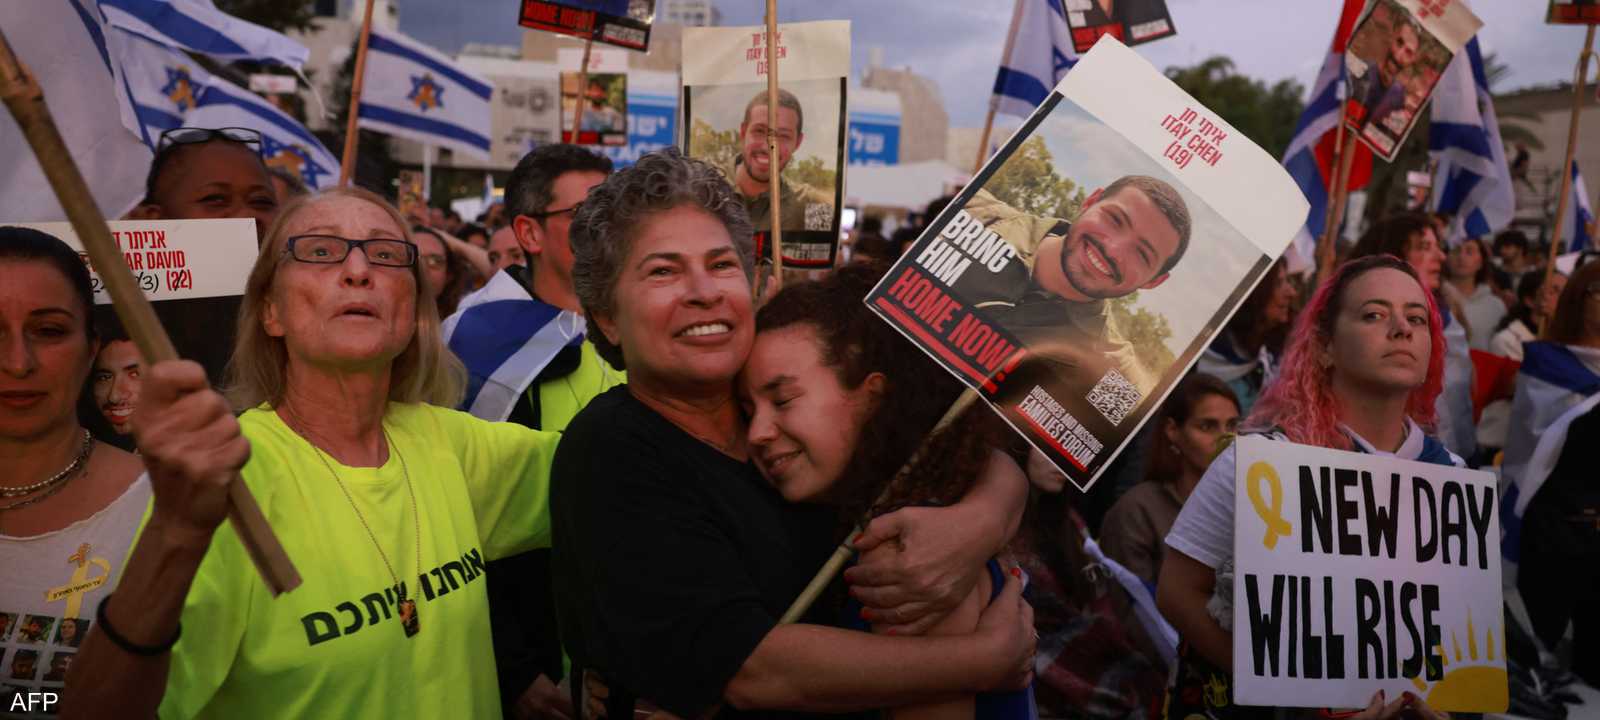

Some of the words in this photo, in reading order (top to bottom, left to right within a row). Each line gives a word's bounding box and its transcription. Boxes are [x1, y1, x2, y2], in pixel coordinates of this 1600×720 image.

[1161, 114, 1192, 140] ITAY
[1187, 134, 1223, 167] CHEN
[1179, 107, 1198, 125] חן
[1199, 117, 1228, 146] איתי
[1163, 140, 1194, 170] (19)
[124, 230, 167, 250] אביתר
[146, 250, 186, 270] DAVID
[915, 236, 973, 288] HIM
[940, 209, 1016, 273] BRING
[887, 266, 963, 334] HOME
[947, 312, 1027, 382] NOW!
[1019, 394, 1065, 439] FAMILIES
[1057, 430, 1097, 468] FORUM
[1030, 384, 1066, 420] HOSTAGES
[1060, 412, 1079, 431] AND
[1071, 423, 1105, 455] MISSING
[1299, 465, 1401, 559] NEW
[1412, 476, 1494, 570] DAY
[419, 547, 486, 602] אנחנו
[1244, 573, 1345, 680] WILL
[1355, 578, 1444, 682] RISE
